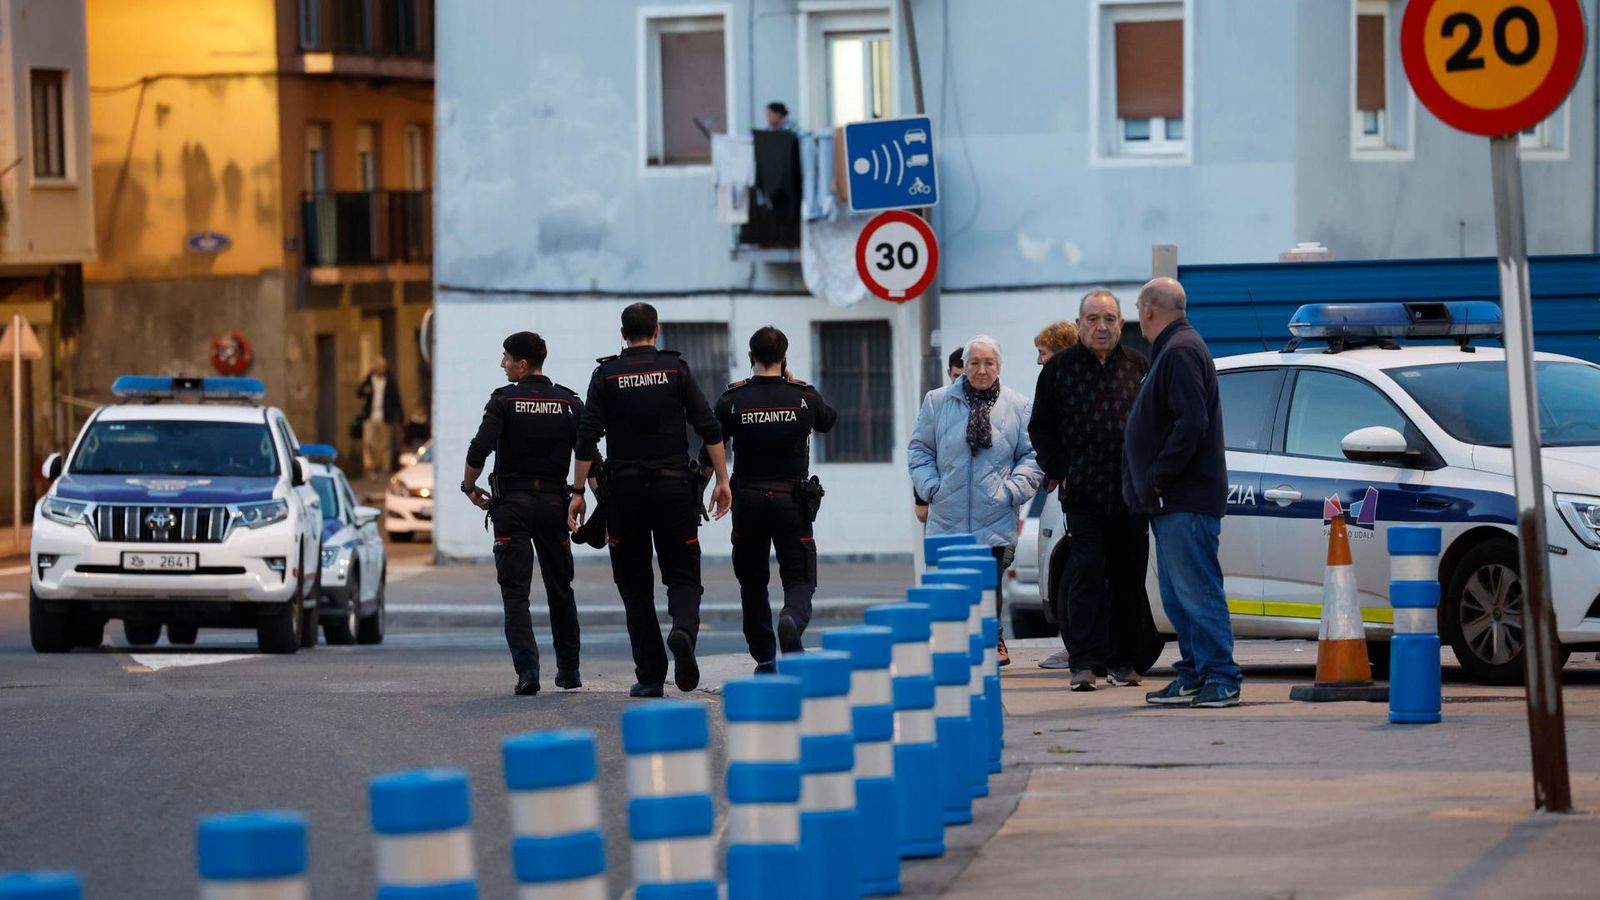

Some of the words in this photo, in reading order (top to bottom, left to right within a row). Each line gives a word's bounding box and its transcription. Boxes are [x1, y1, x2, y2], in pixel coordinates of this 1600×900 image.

[1441, 6, 1540, 72] 20
[875, 241, 918, 271] 30
[618, 372, 669, 389] ERTZAINTZA
[515, 401, 563, 414] ERTZAINTZA
[741, 411, 797, 424] ERTZAINTZA
[1226, 484, 1256, 506] ZIA
[160, 556, 190, 568] 2641
